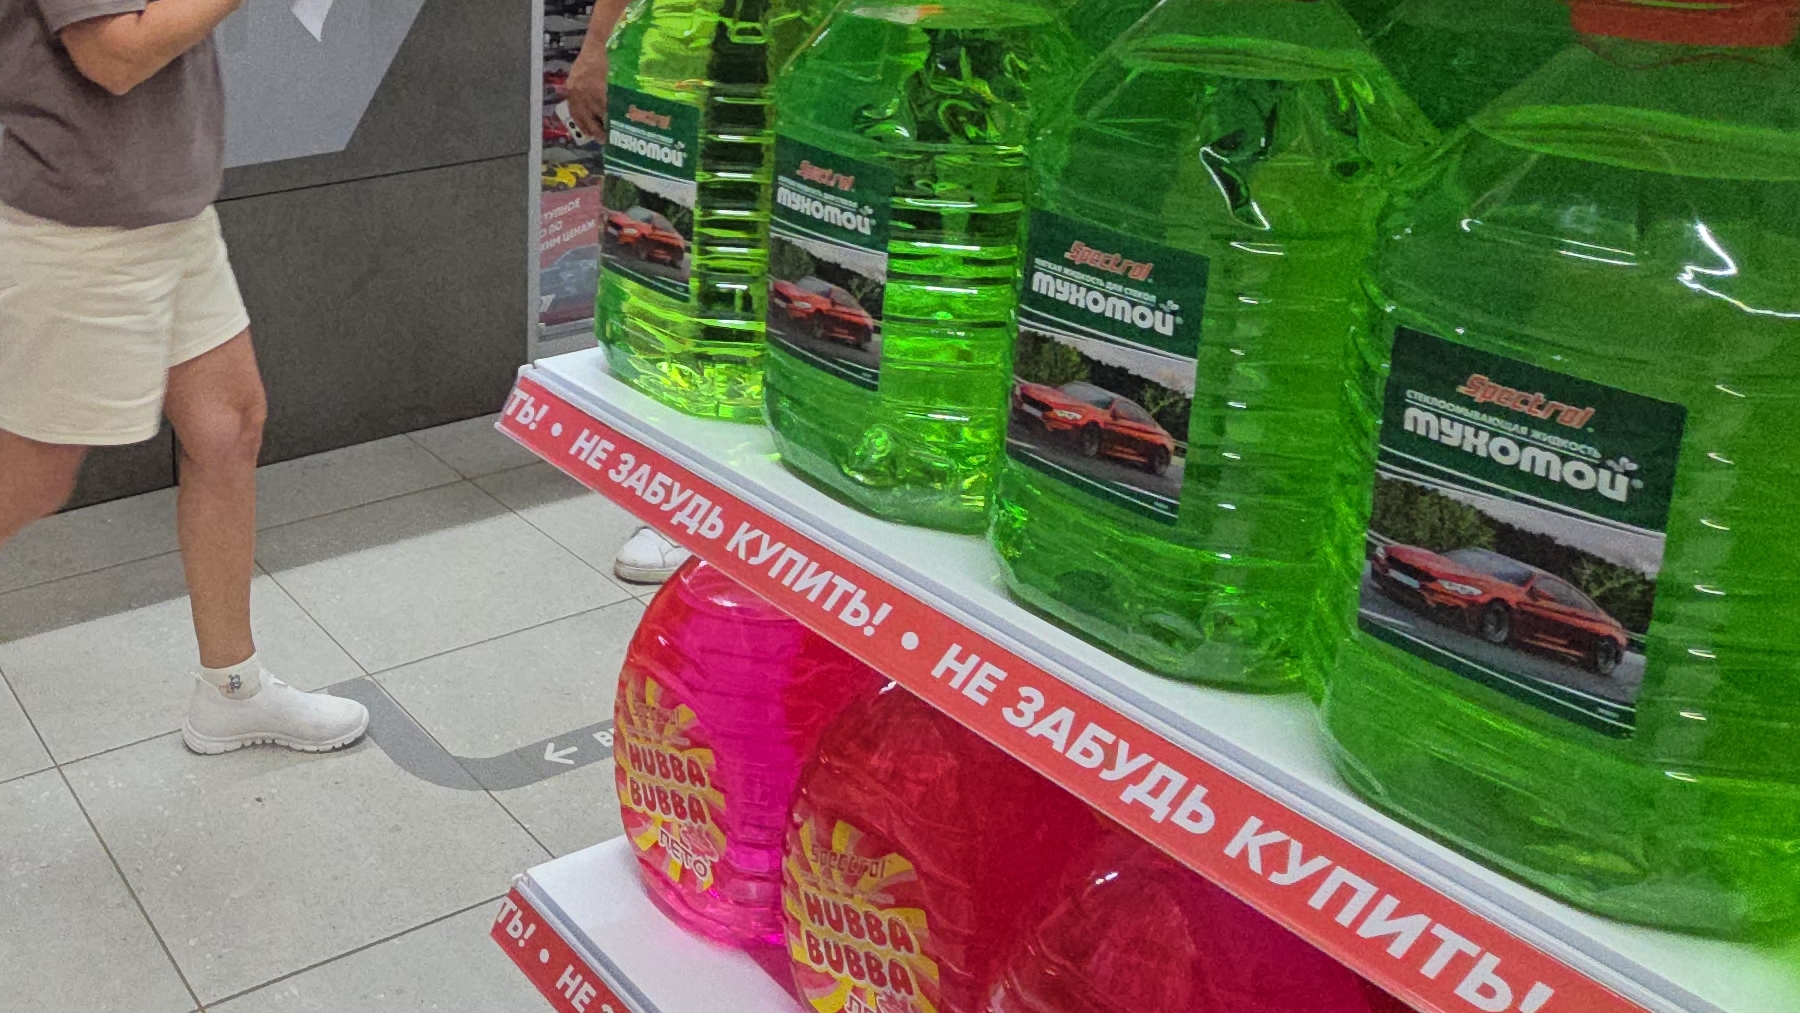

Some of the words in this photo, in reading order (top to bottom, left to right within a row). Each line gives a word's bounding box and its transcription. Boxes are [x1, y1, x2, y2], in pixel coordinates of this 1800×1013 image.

[568, 429, 616, 470] НЕ
[607, 452, 727, 540] ЗАБУДЬ
[726, 521, 894, 638] КУПИТЬ!
[930, 642, 1008, 707] НЕ
[1001, 685, 1216, 836] ЗАБУДЬ
[630, 744, 708, 788] HUBBA
[630, 777, 708, 826] BUBBA
[803, 887, 915, 953] HUBBA
[805, 928, 915, 996] BUBBA
